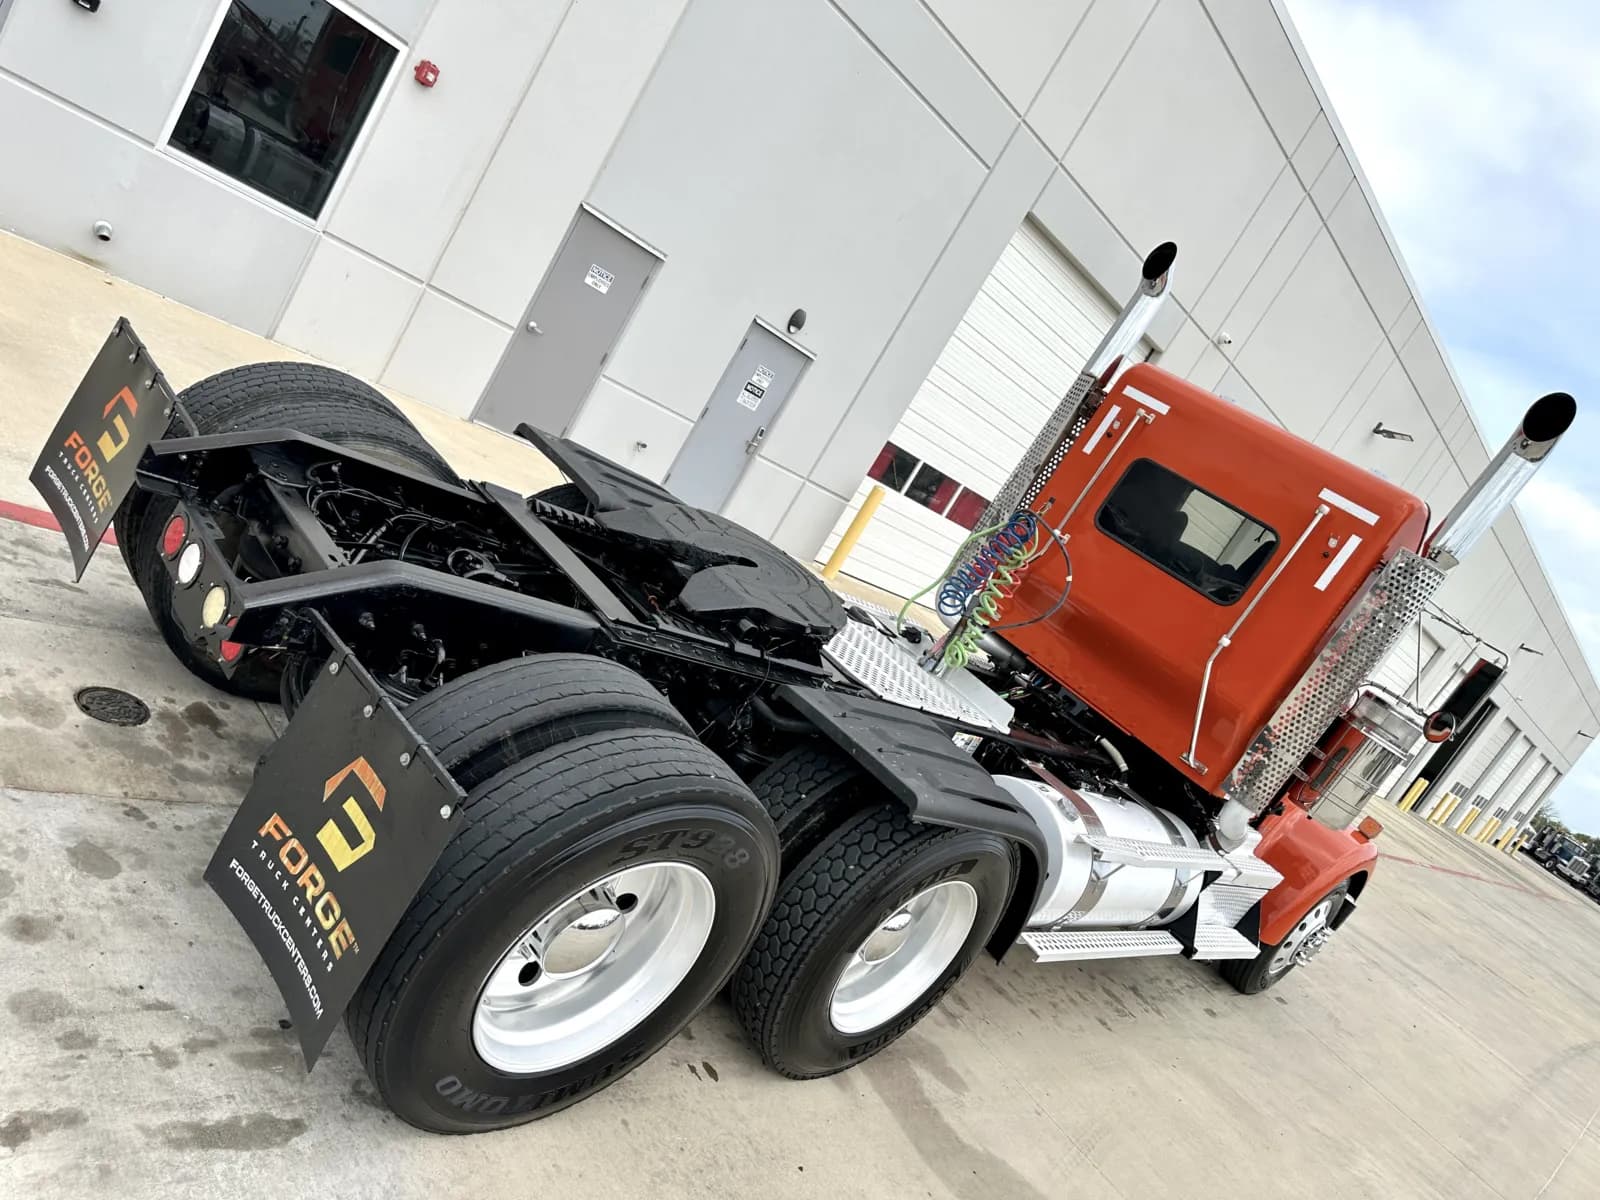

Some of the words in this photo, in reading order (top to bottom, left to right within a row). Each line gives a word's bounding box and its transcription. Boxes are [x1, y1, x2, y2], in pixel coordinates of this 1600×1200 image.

[58, 451, 80, 485] TRUCK
[64, 431, 111, 512] FORGE
[258, 812, 356, 960] FORGE
[609, 828, 751, 869] ST928
[229, 857, 325, 1020] FORGETRUCKCENTERS.COM
[251, 839, 289, 892] TRUCK
[292, 896, 334, 972] CENTERS
